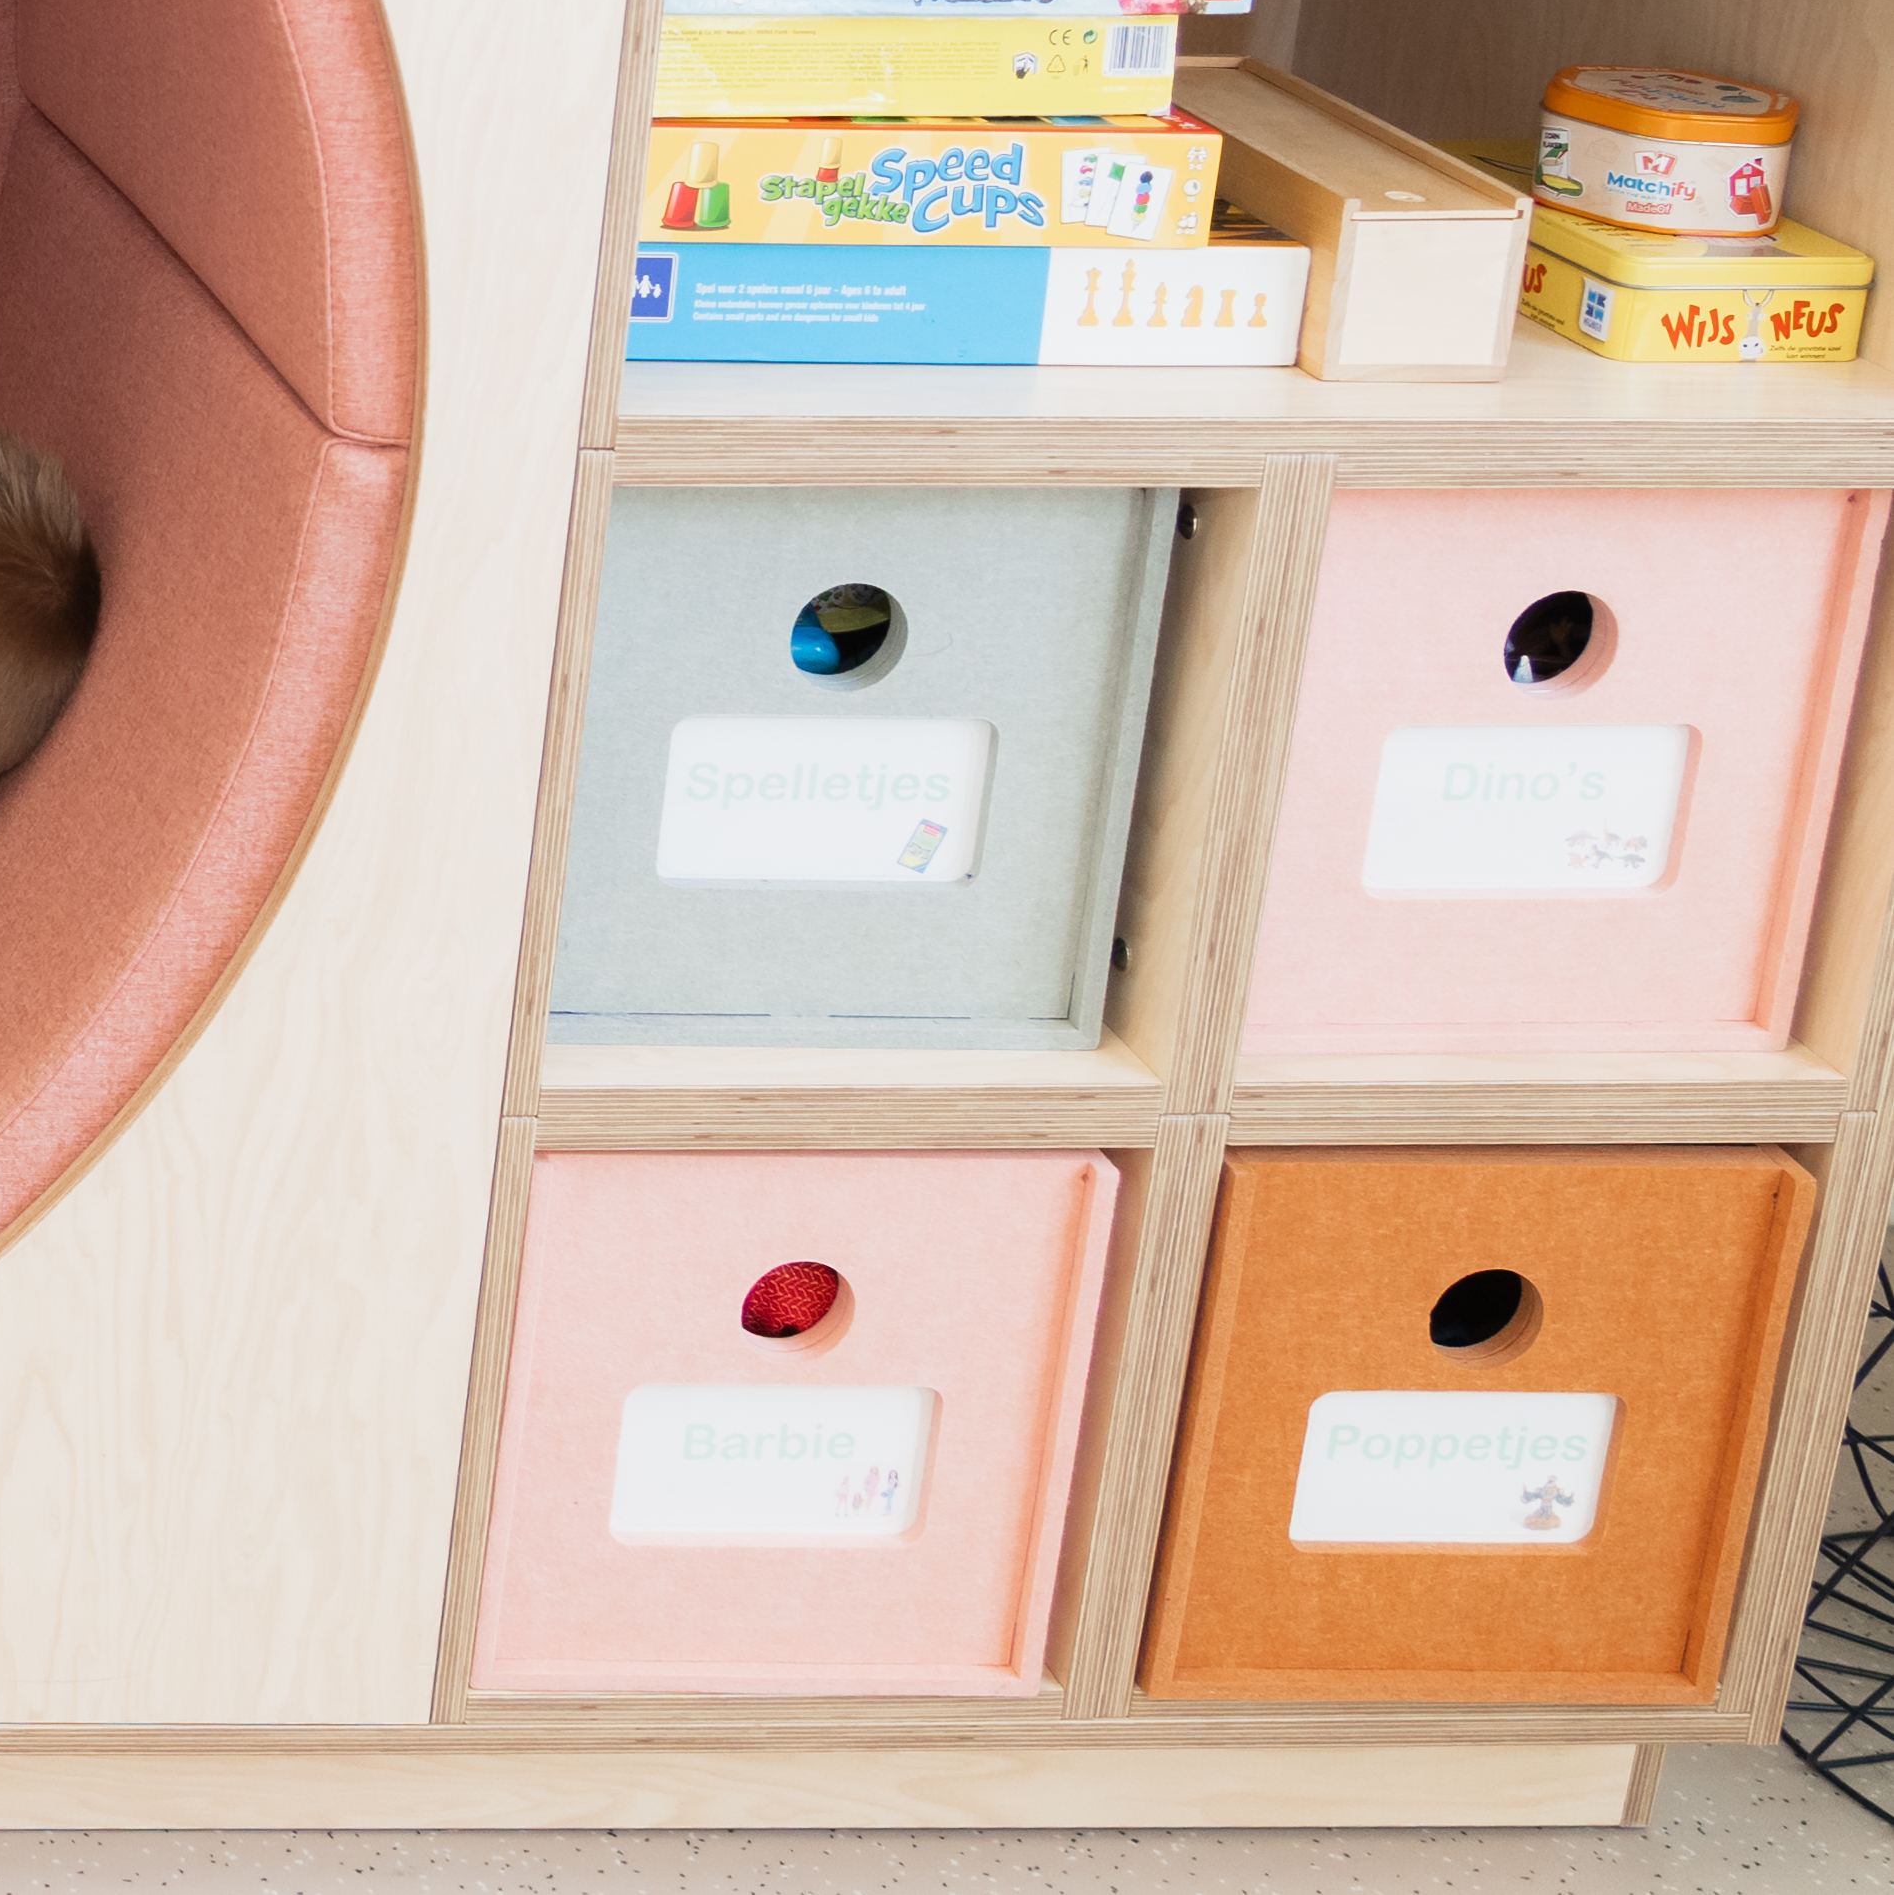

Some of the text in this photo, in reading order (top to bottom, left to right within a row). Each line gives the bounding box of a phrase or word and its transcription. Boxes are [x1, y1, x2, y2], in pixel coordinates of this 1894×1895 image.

[760, 172, 866, 204] Stapel
[868, 143, 1023, 206] Speed
[1607, 171, 1696, 201] Matchify
[822, 194, 910, 226] gekke
[912, 184, 1044, 233] Cups
[1626, 201, 1672, 214] MadeOf
[695, 282, 716, 295] Spel
[718, 285, 736, 294] voor
[738, 284, 745, 294] 2
[746, 283, 778, 296] spelers
[1661, 300, 1845, 351] WIJS NEUS
[685, 762, 950, 810] Spelletjes
[1442, 762, 1605, 801] Dino's
[682, 1423, 855, 1460] Barbie
[1326, 1424, 1588, 1470] Poppetjes
